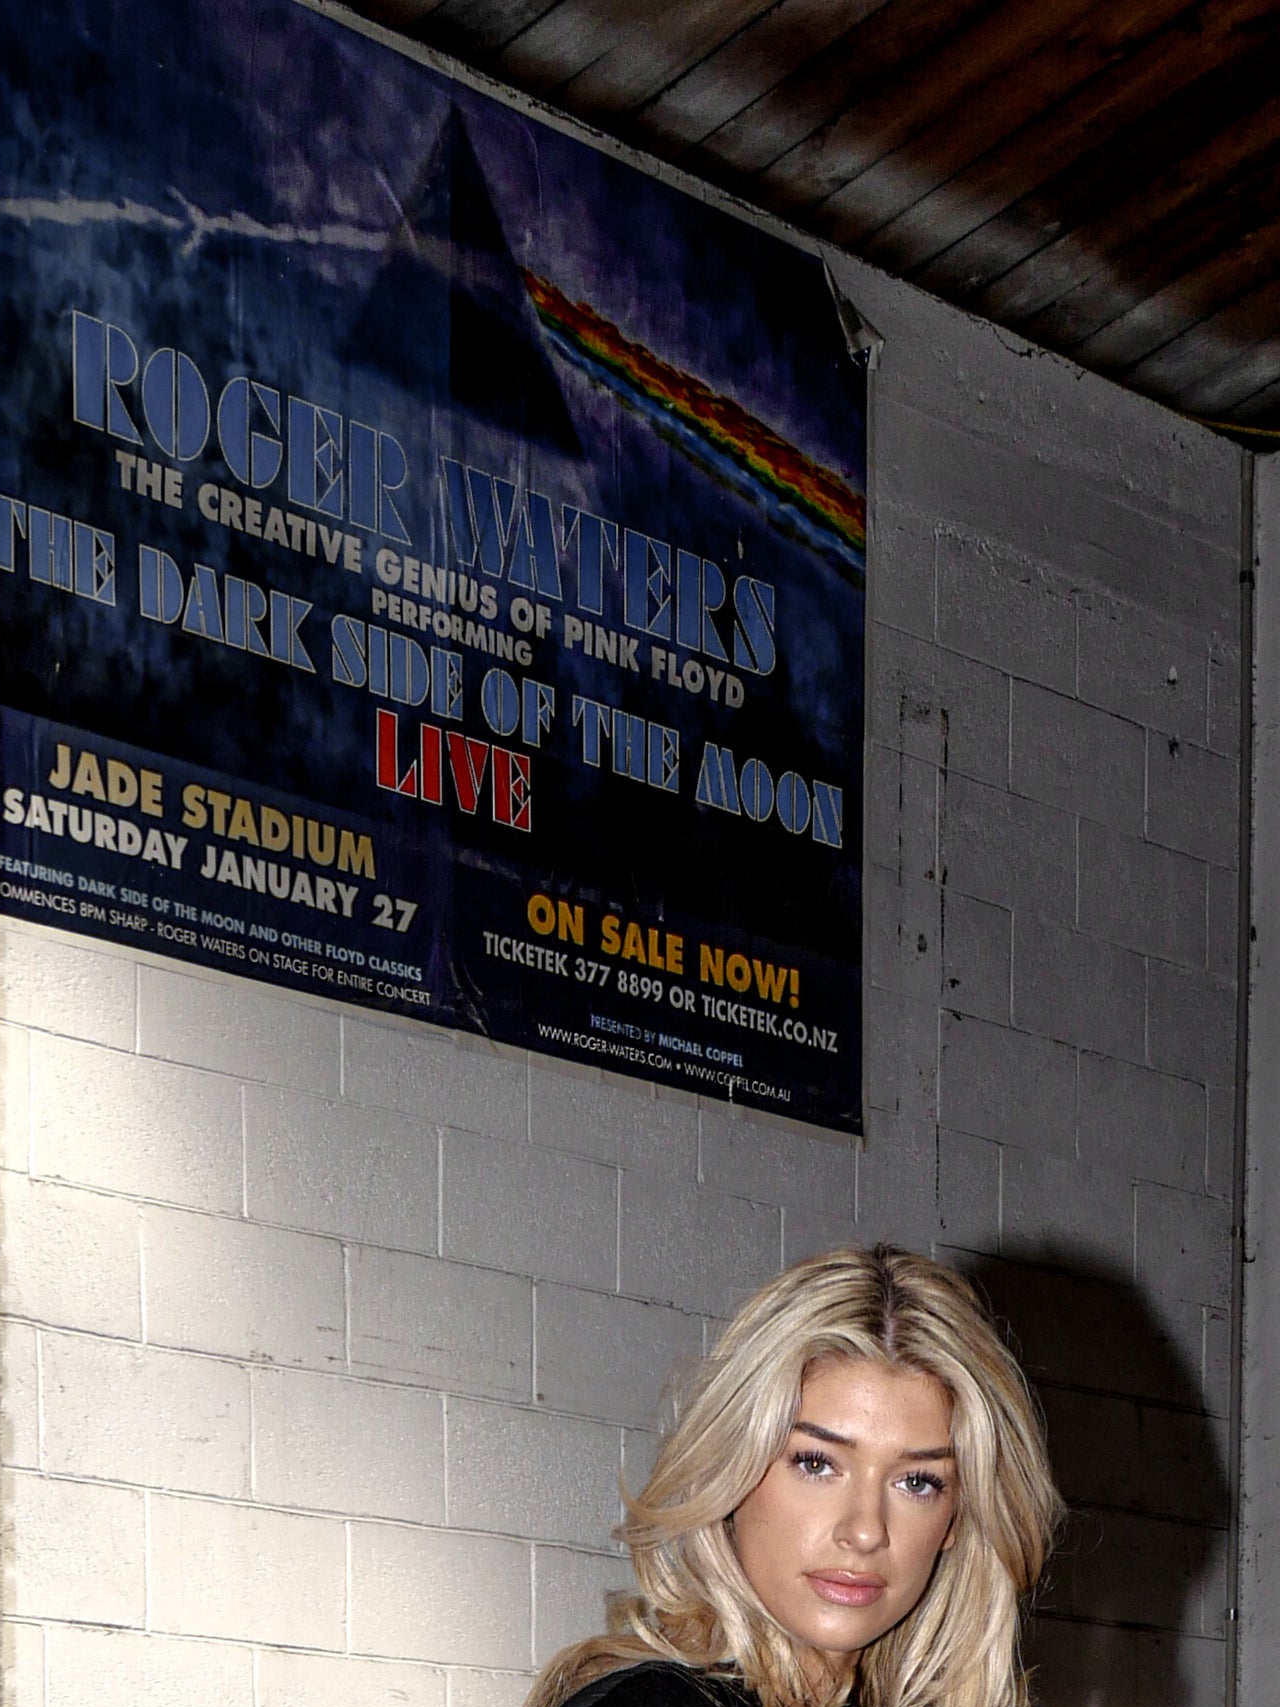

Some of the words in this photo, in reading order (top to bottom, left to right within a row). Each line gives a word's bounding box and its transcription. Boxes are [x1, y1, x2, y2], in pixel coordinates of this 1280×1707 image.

[72, 309, 412, 546] ROGER
[441, 456, 776, 676] WATERS
[116, 449, 183, 509] THE
[197, 483, 362, 574] CREATIVE
[375, 548, 498, 619] GENIUS
[510, 592, 552, 639] OF
[564, 616, 640, 673] PINK
[651, 646, 745, 709] FLOYD
[371, 587, 533, 666] PERFORMING
[139, 544, 317, 674] DARK
[330, 613, 463, 721] SIDE
[481, 668, 555, 748] OF
[572, 695, 680, 794] THE
[695, 741, 843, 849] MOON
[48, 743, 164, 818] JADE
[181, 784, 376, 880] STADIUM
[376, 708, 531, 833] LIVE
[2, 788, 189, 870] SATURDAY
[200, 844, 359, 918] JANUARY
[371, 893, 418, 933] 27
[78, 875, 116, 900] DARK
[120, 887, 149, 908] SIDE
[152, 897, 170, 914] OF
[173, 902, 198, 922] THE
[201, 909, 245, 935] MOON
[249, 923, 278, 943] AND
[281, 931, 322, 956] OTHER
[325, 943, 365, 966] FLOYD
[368, 955, 422, 982] CLASSICS
[79, 901, 106, 922] 8PM
[109, 909, 148, 932] SHARP
[157, 922, 197, 947] ROGER
[200, 934, 246, 960] WATERS
[248, 948, 270, 966] ON
[273, 953, 308, 976] STAGE
[311, 964, 335, 981] FOR
[337, 970, 373, 993] ENTIRE
[376, 981, 431, 1007] CONCERT
[527, 894, 584, 946] ON
[600, 914, 683, 975] SALE
[700, 943, 799, 1009] NOW!
[483, 930, 569, 977] TICKETEK
[574, 957, 611, 987] 377
[617, 969, 663, 1003] 8899
[669, 985, 696, 1013] OR
[701, 993, 838, 1054] TICKETEK.CO.NZ
[590, 1013, 642, 1040] PRESENTED
[643, 1029, 656, 1044] BY
[658, 1032, 704, 1058] MICHAEL
[705, 1046, 744, 1068] COPPEL
